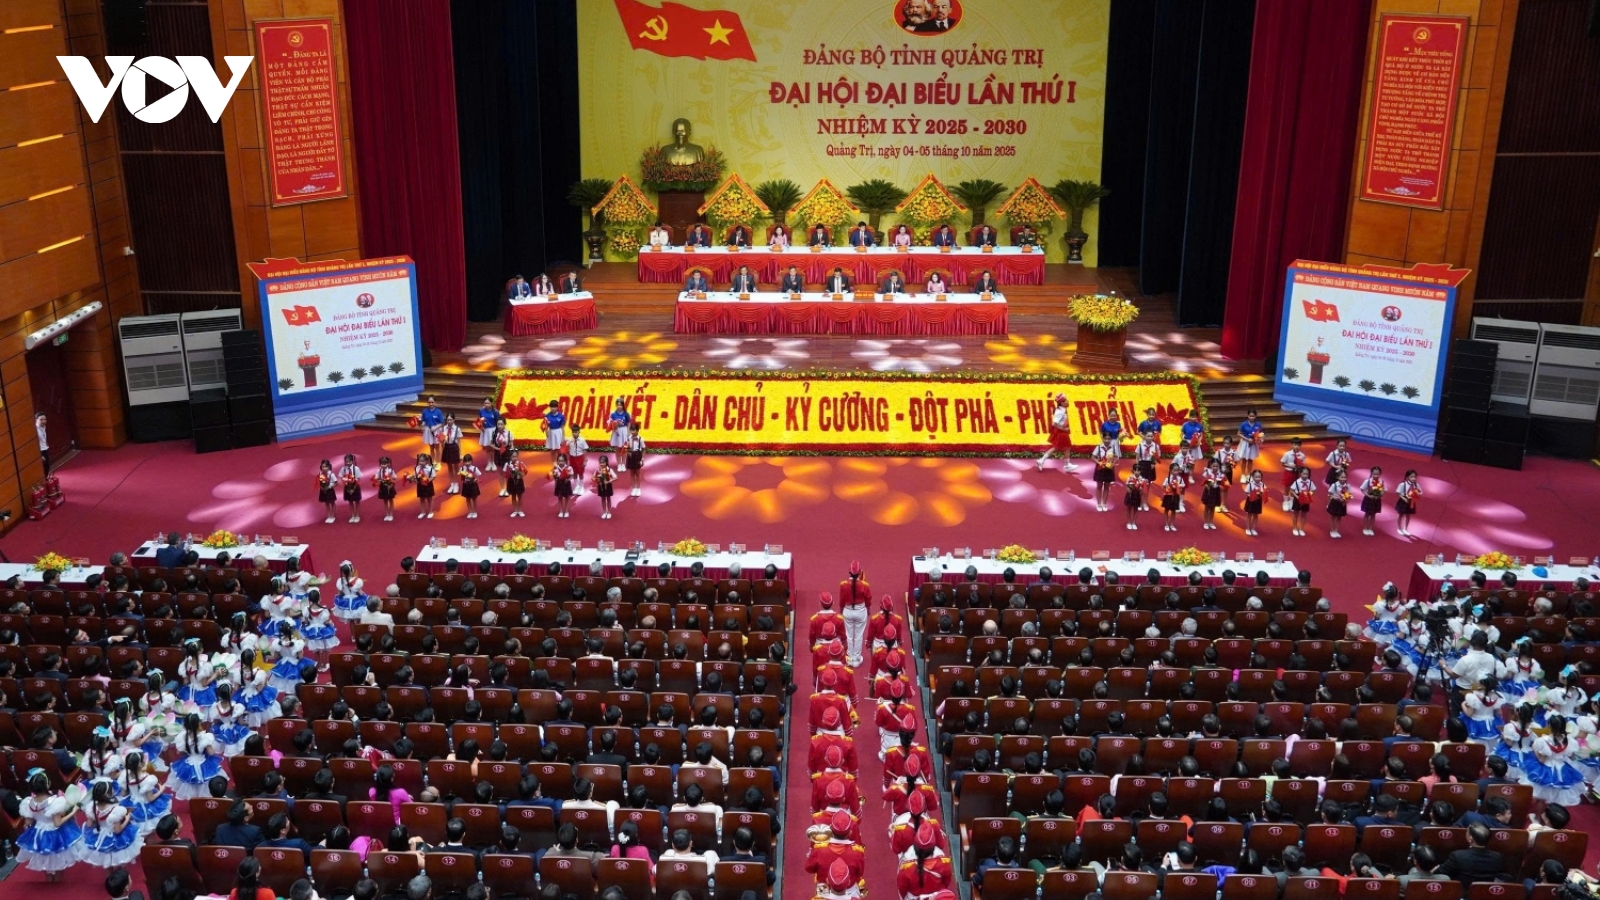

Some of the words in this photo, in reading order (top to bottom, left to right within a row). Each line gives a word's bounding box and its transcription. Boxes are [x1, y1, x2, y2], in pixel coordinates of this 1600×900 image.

[803, 43, 856, 65] ĐẢNG
[860, 45, 886, 69] BỘ
[890, 43, 936, 65] TỈNH
[942, 43, 1007, 68] QUẢNG
[1012, 49, 1044, 68] TRỊ
[768, 82, 810, 108] ĐẠI
[818, 76, 859, 109] HỘI
[865, 82, 906, 109] ĐẠI
[914, 72, 961, 105] BIỂU
[968, 73, 1014, 105] LẦN
[1021, 73, 1064, 104] THỨ
[1067, 81, 1077, 103] I
[817, 114, 887, 138] NHIỆM
[892, 113, 921, 134] KỲ
[925, 119, 968, 135] 2025
[983, 119, 1027, 135] 2030
[826, 142, 857, 158] Quảng
[859, 144, 876, 158] Trị,
[878, 146, 901, 159] ngày
[932, 145, 959, 159] tháng
[961, 146, 971, 156] 10
[974, 146, 992, 156] năm
[994, 146, 1016, 157] 2025
[325, 325, 337, 335] ĐẠI
[338, 322, 350, 333] HỘI
[351, 323, 362, 332] ĐẠI
[1342, 329, 1354, 339] ĐẠI
[1356, 330, 1368, 342] HỘI
[1370, 333, 1382, 343] ĐẠI
[1384, 332, 1397, 344] BIỂU
[674, 388, 718, 430] DÂN
[723, 382, 765, 431] CHỦ
[786, 382, 812, 431] KỶ
[909, 390, 948, 440] ĐỘT
[954, 391, 1000, 433] PHÁ
